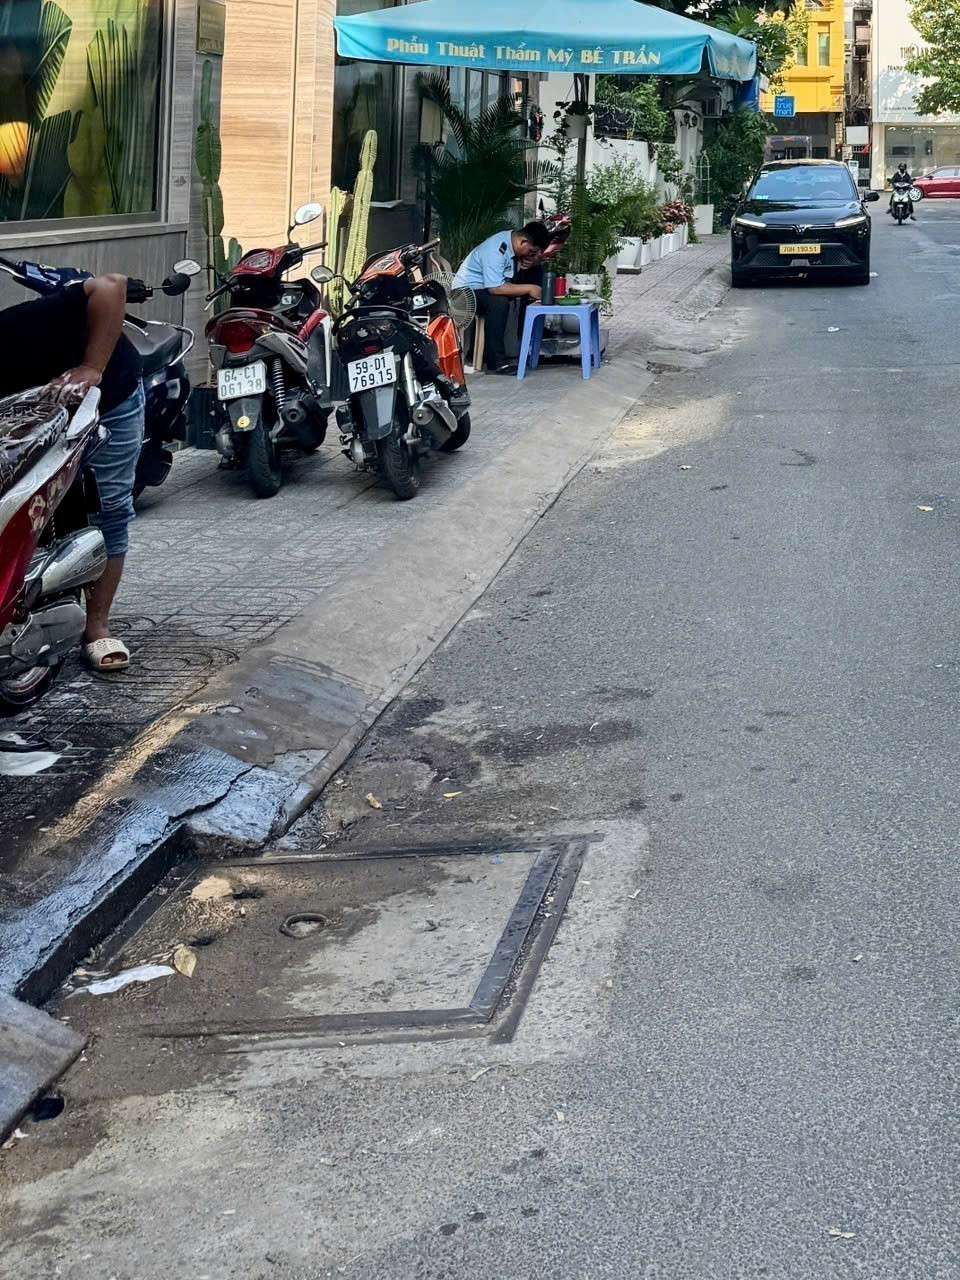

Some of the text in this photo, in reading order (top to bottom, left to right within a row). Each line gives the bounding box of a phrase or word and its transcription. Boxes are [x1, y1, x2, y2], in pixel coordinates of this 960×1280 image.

[436, 42, 485, 62] Thuật
[494, 41, 540, 61] Thẩm
[547, 48, 575, 66] Mỹ
[224, 367, 256, 383] 64-C1
[353, 369, 393, 389] 769.15
